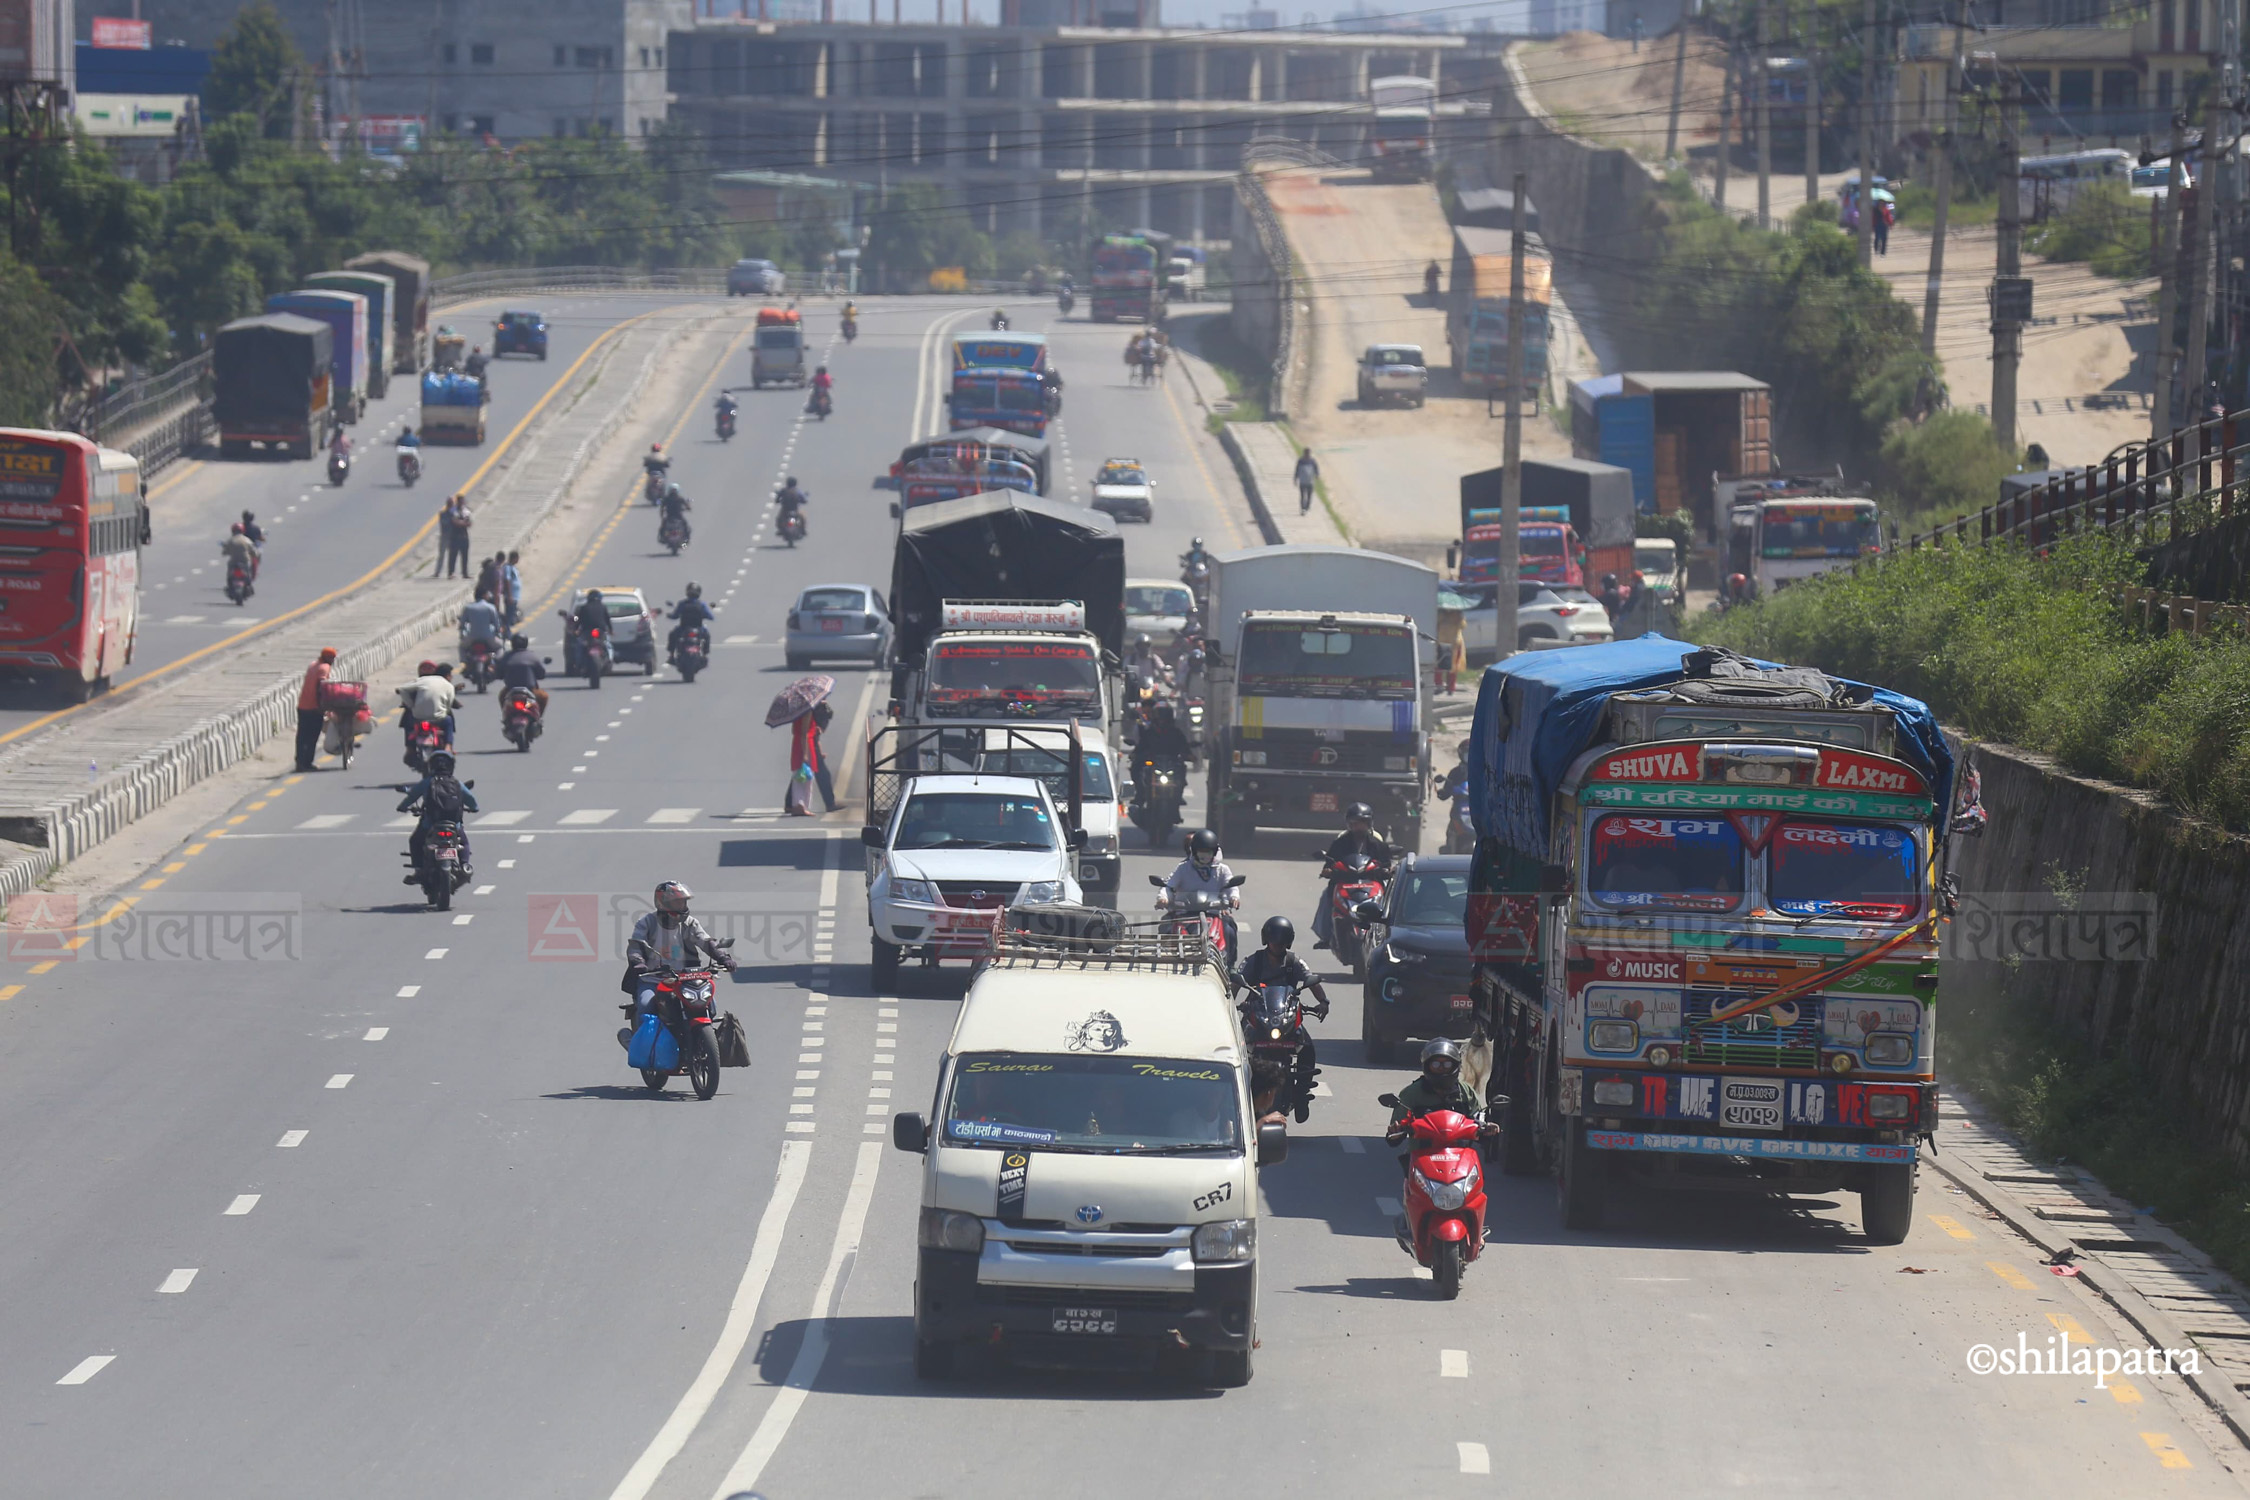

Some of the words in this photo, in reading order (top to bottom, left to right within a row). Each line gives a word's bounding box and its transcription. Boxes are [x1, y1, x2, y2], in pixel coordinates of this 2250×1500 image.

[1609, 752, 1689, 779] SHUVA
[1827, 761, 1907, 790] LAXMI
[1595, 787, 1635, 802] श्री
[1742, 792, 1807, 808] माई
[1813, 796, 1857, 812] की
[1628, 818, 1724, 837] शुभ
[1625, 962, 1679, 979] MUSIC
[1730, 967, 1779, 982] TATA
[1590, 1000, 1608, 1009] MOM
[1660, 1000, 1677, 1011] DAD
[1827, 1010, 1845, 1020] MOM
[1897, 1014, 1912, 1023] DAD
[966, 1062, 1053, 1073] Saurav
[1132, 1064, 1221, 1081] Travels
[1592, 1133, 1636, 1149] शुभ
[1865, 1146, 1909, 1160] यात्रा
[1000, 1167, 1025, 1182] NEXT
[998, 1178, 1024, 1195] TIME
[1193, 1181, 1232, 1212] CR7
